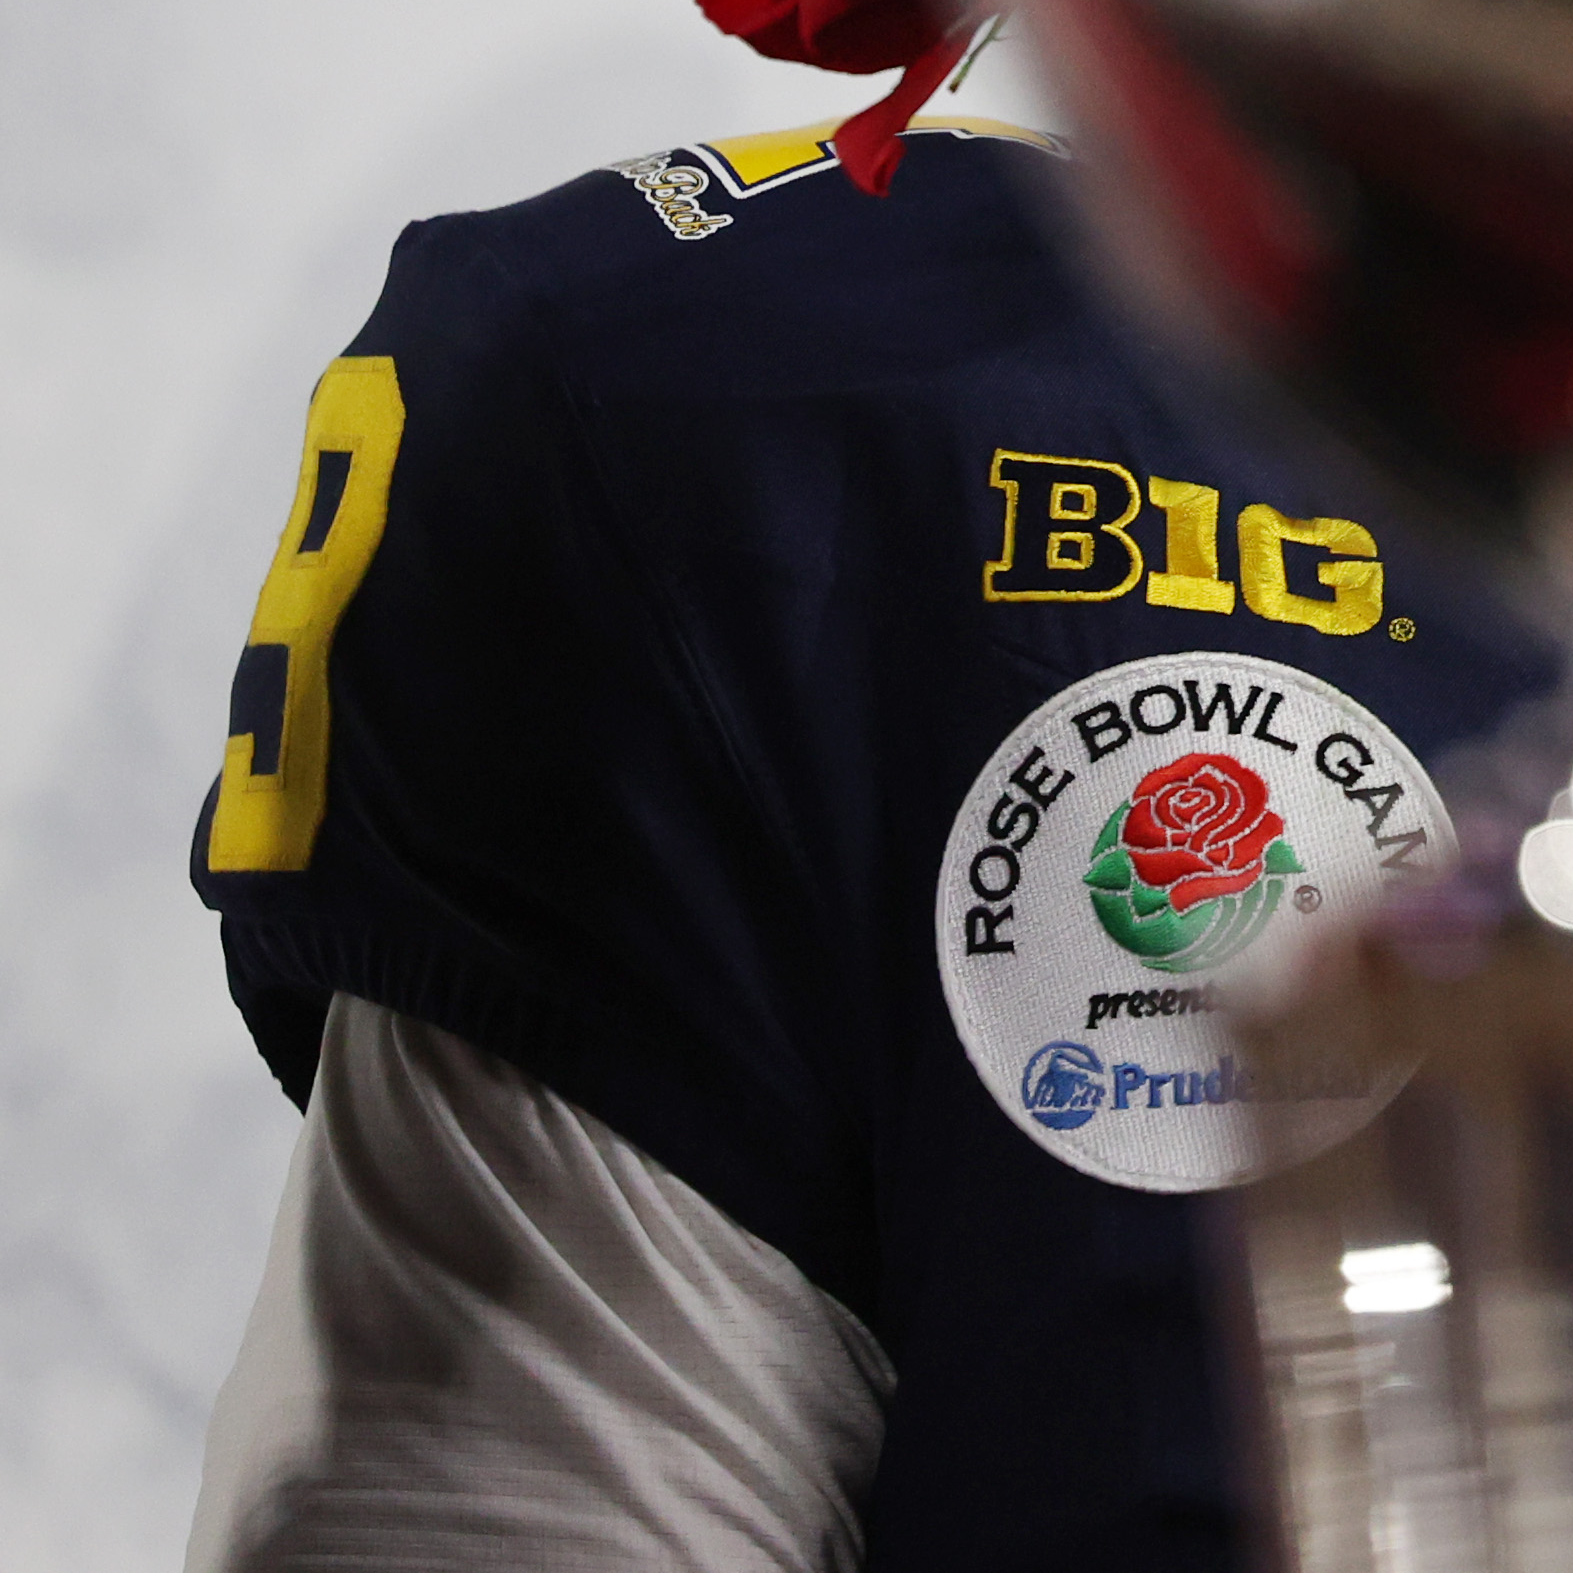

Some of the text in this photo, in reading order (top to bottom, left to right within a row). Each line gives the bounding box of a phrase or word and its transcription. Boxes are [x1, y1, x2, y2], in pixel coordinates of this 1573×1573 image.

[208, 356, 406, 872] 9
[966, 679, 1428, 956] ROSE BOWL GAM
